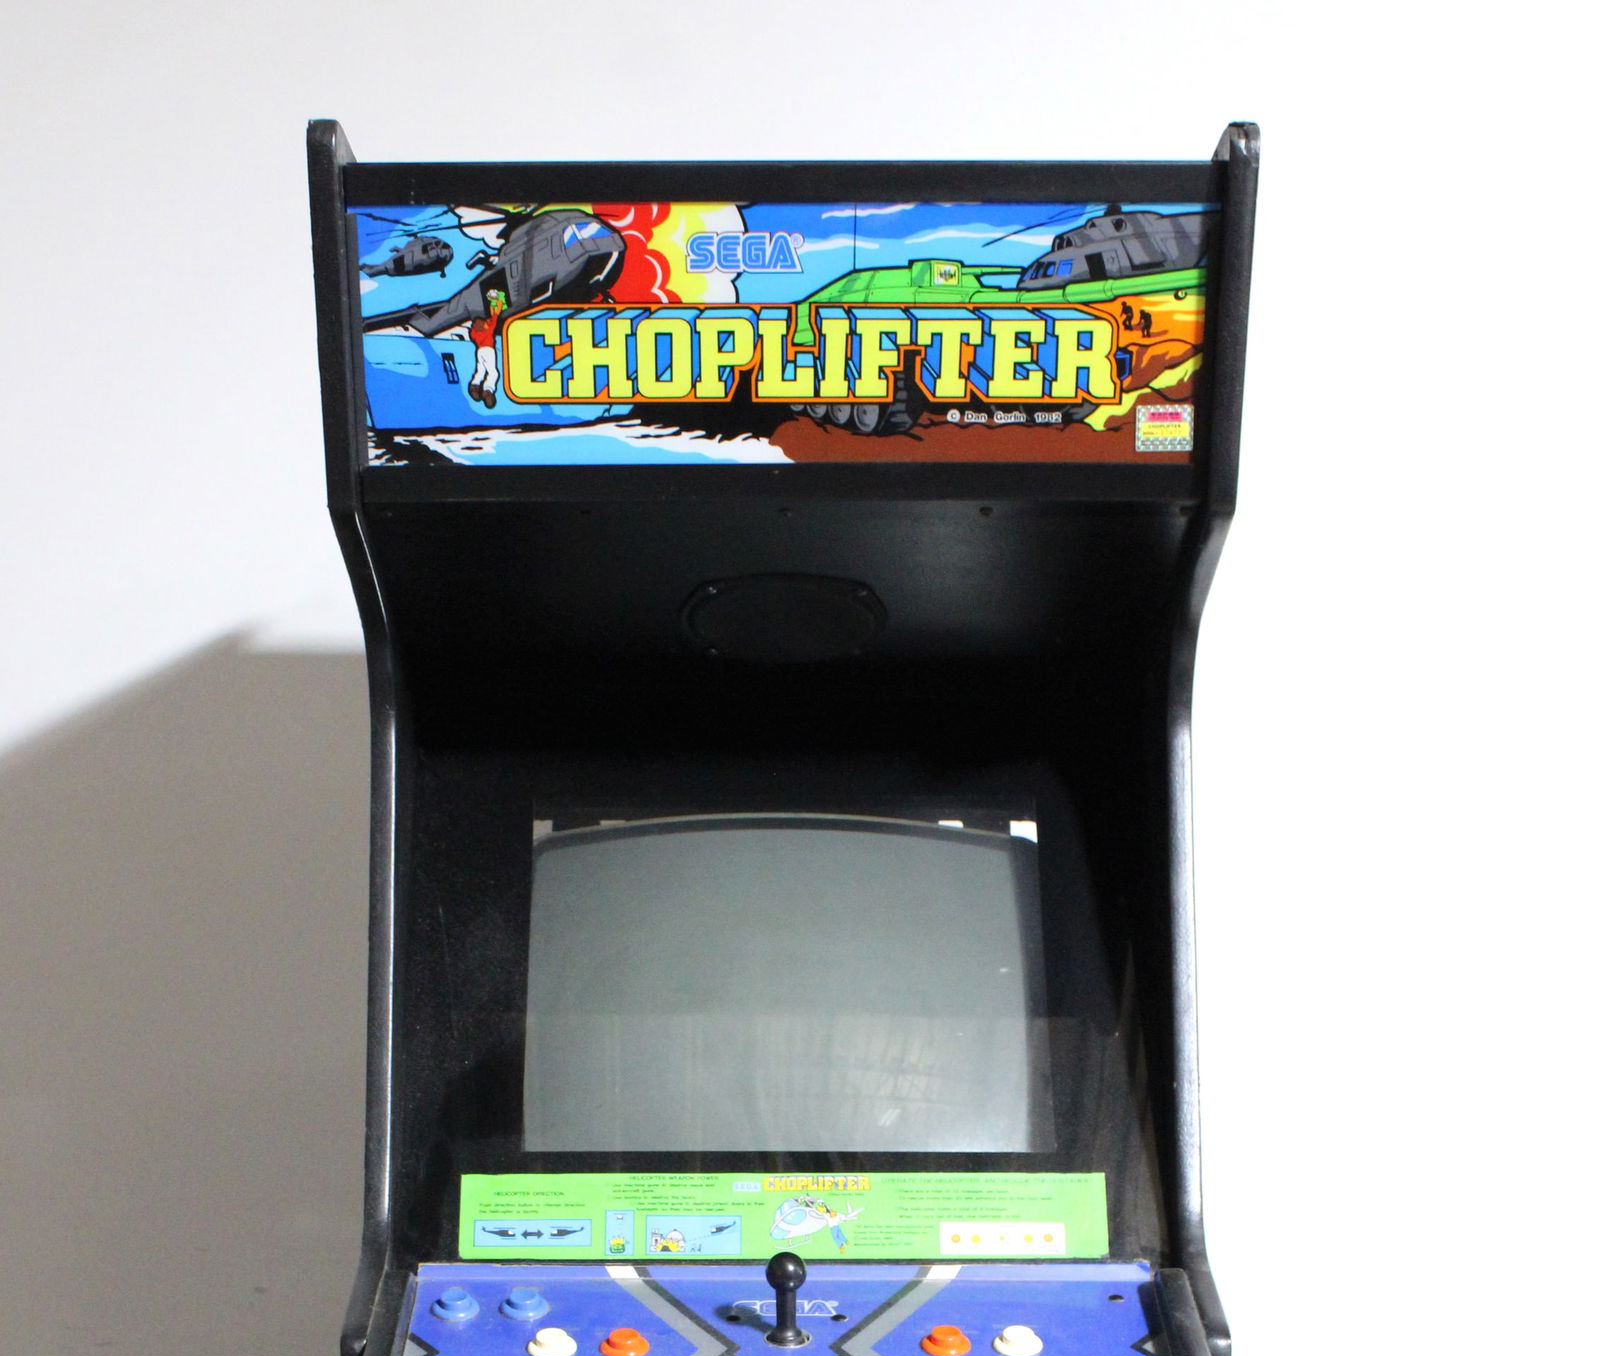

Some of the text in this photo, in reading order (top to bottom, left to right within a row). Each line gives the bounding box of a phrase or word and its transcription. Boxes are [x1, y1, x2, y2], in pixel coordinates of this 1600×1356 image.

[687, 232, 803, 273] SEGA
[505, 306, 1117, 399] CHOPLIFTER
[964, 410, 987, 422] Dan
[994, 410, 1026, 423] Gorlin
[763, 1175, 870, 1191] CHOPLIFTER
